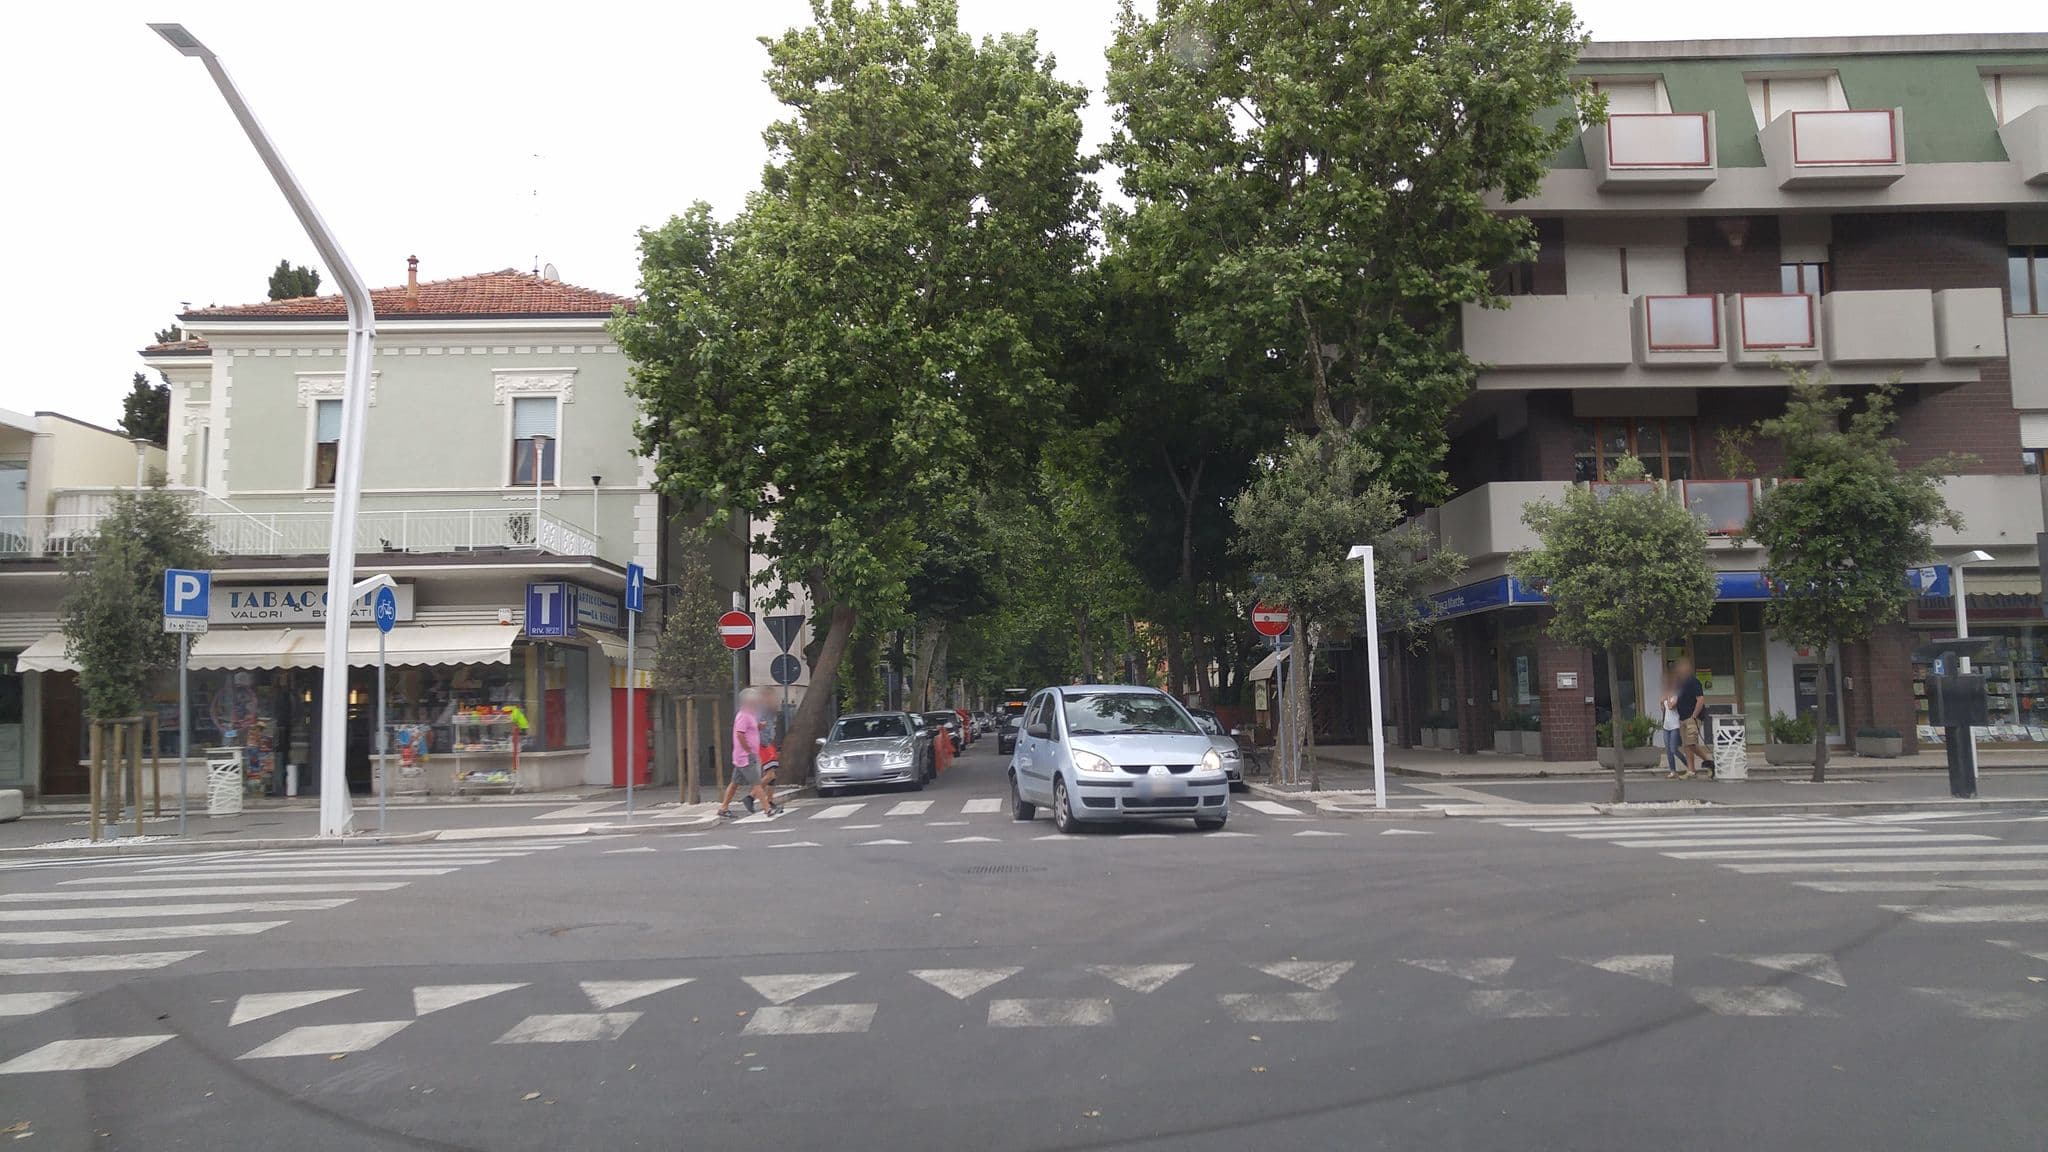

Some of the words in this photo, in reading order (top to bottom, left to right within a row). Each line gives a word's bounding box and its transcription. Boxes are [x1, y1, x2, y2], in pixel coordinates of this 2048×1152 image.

[174, 574, 200, 611] P
[229, 591, 372, 607] TABACI
[293, 602, 303, 612] &
[534, 585, 559, 625] T
[312, 609, 372, 618] BOATI
[1935, 659, 1942, 673] P
